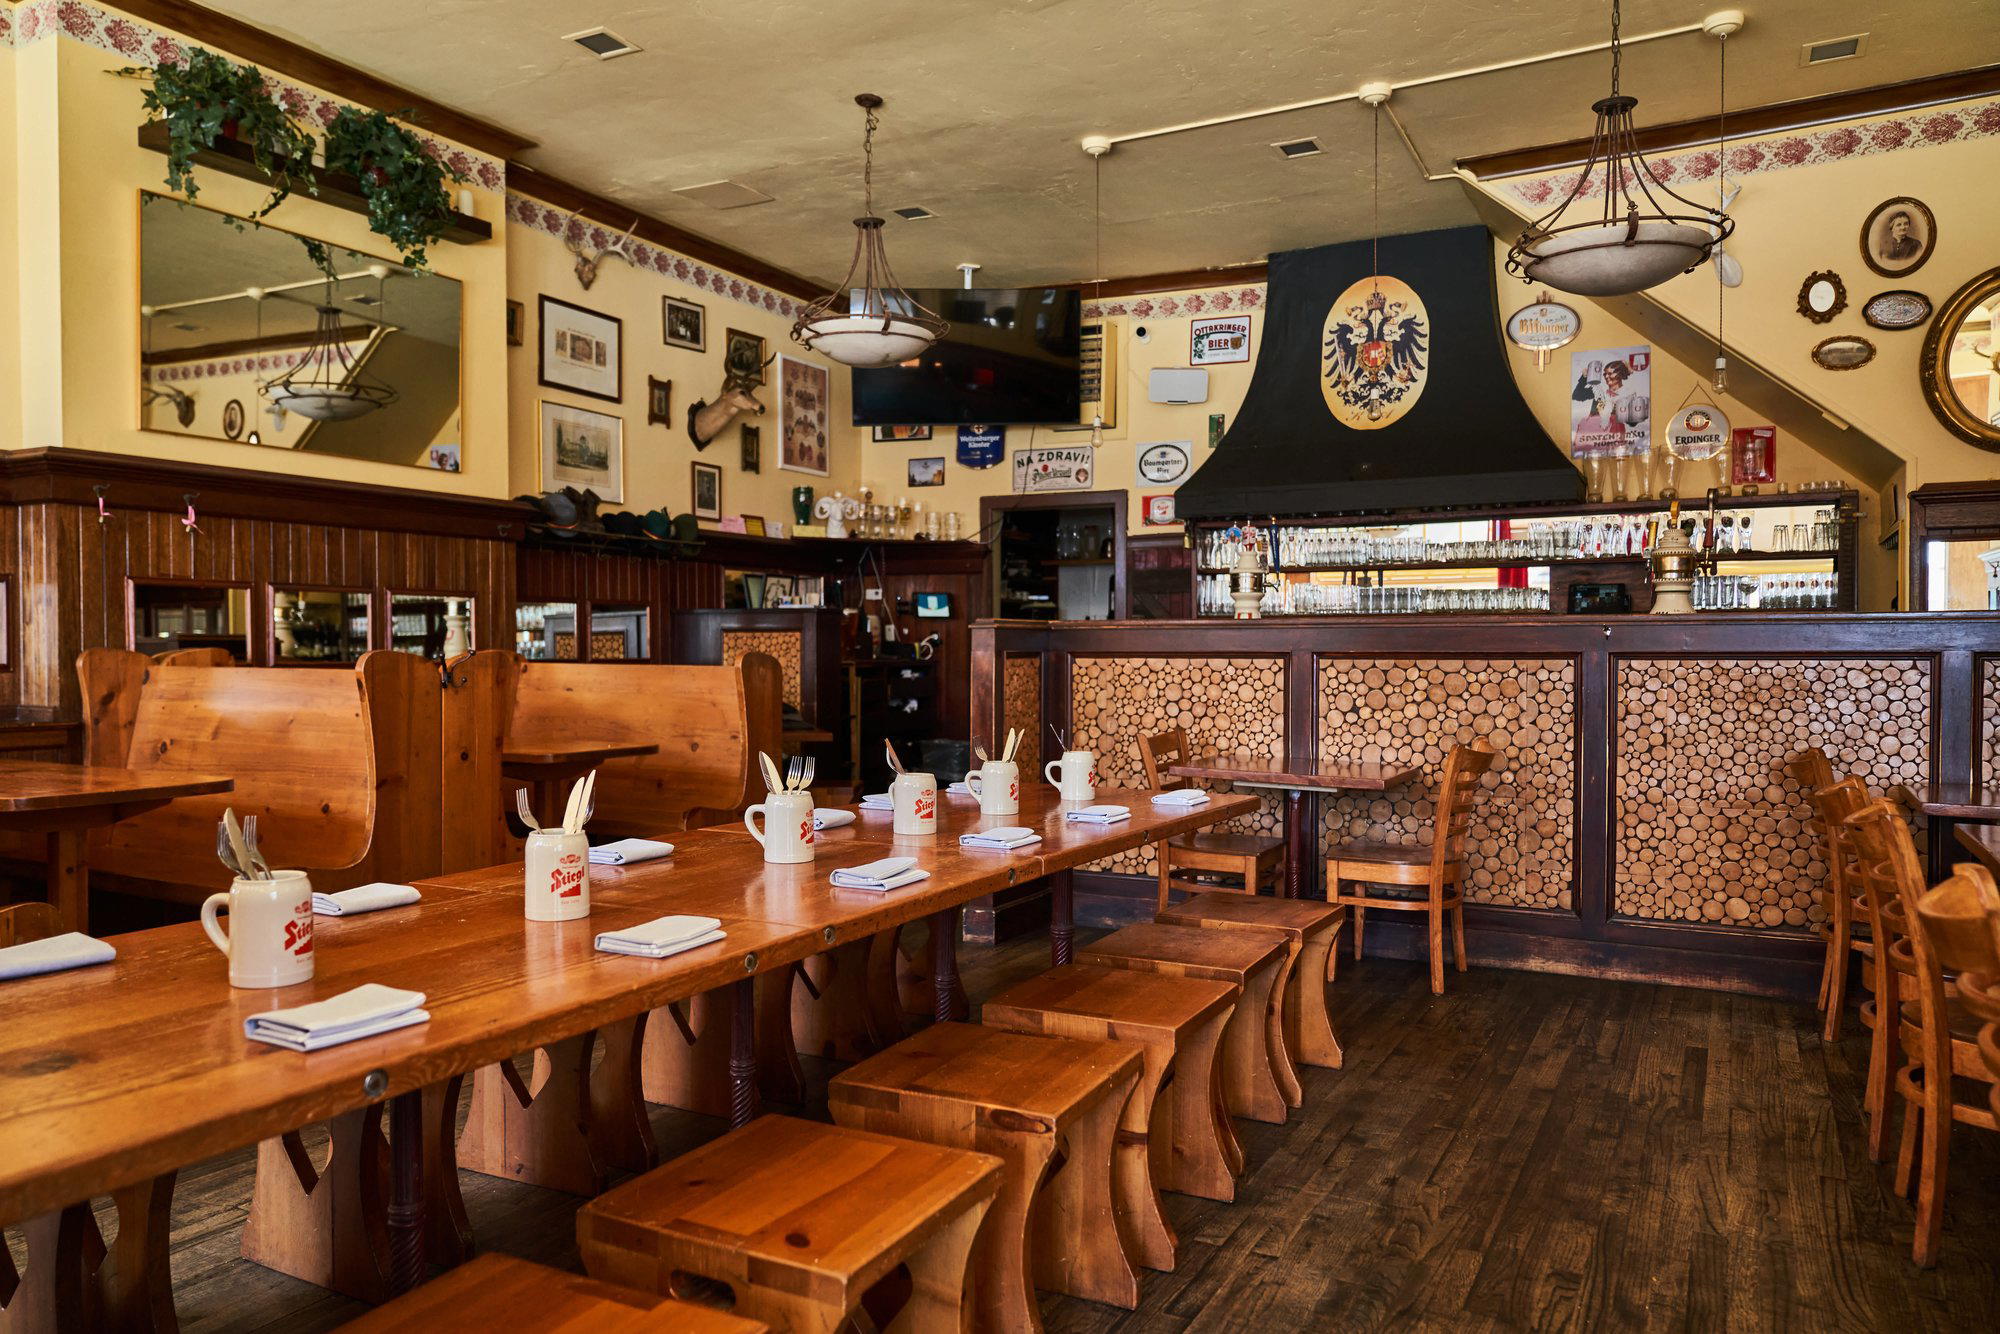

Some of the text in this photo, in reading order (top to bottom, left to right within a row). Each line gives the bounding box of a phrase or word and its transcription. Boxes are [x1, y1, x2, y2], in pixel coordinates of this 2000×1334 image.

[1194, 323, 1247, 337] OTTAKRINGER
[1208, 338, 1230, 348] BIER
[1675, 433, 1721, 445] ERDINGER
[1016, 455, 1034, 468] NA
[551, 865, 584, 893] Stiegl
